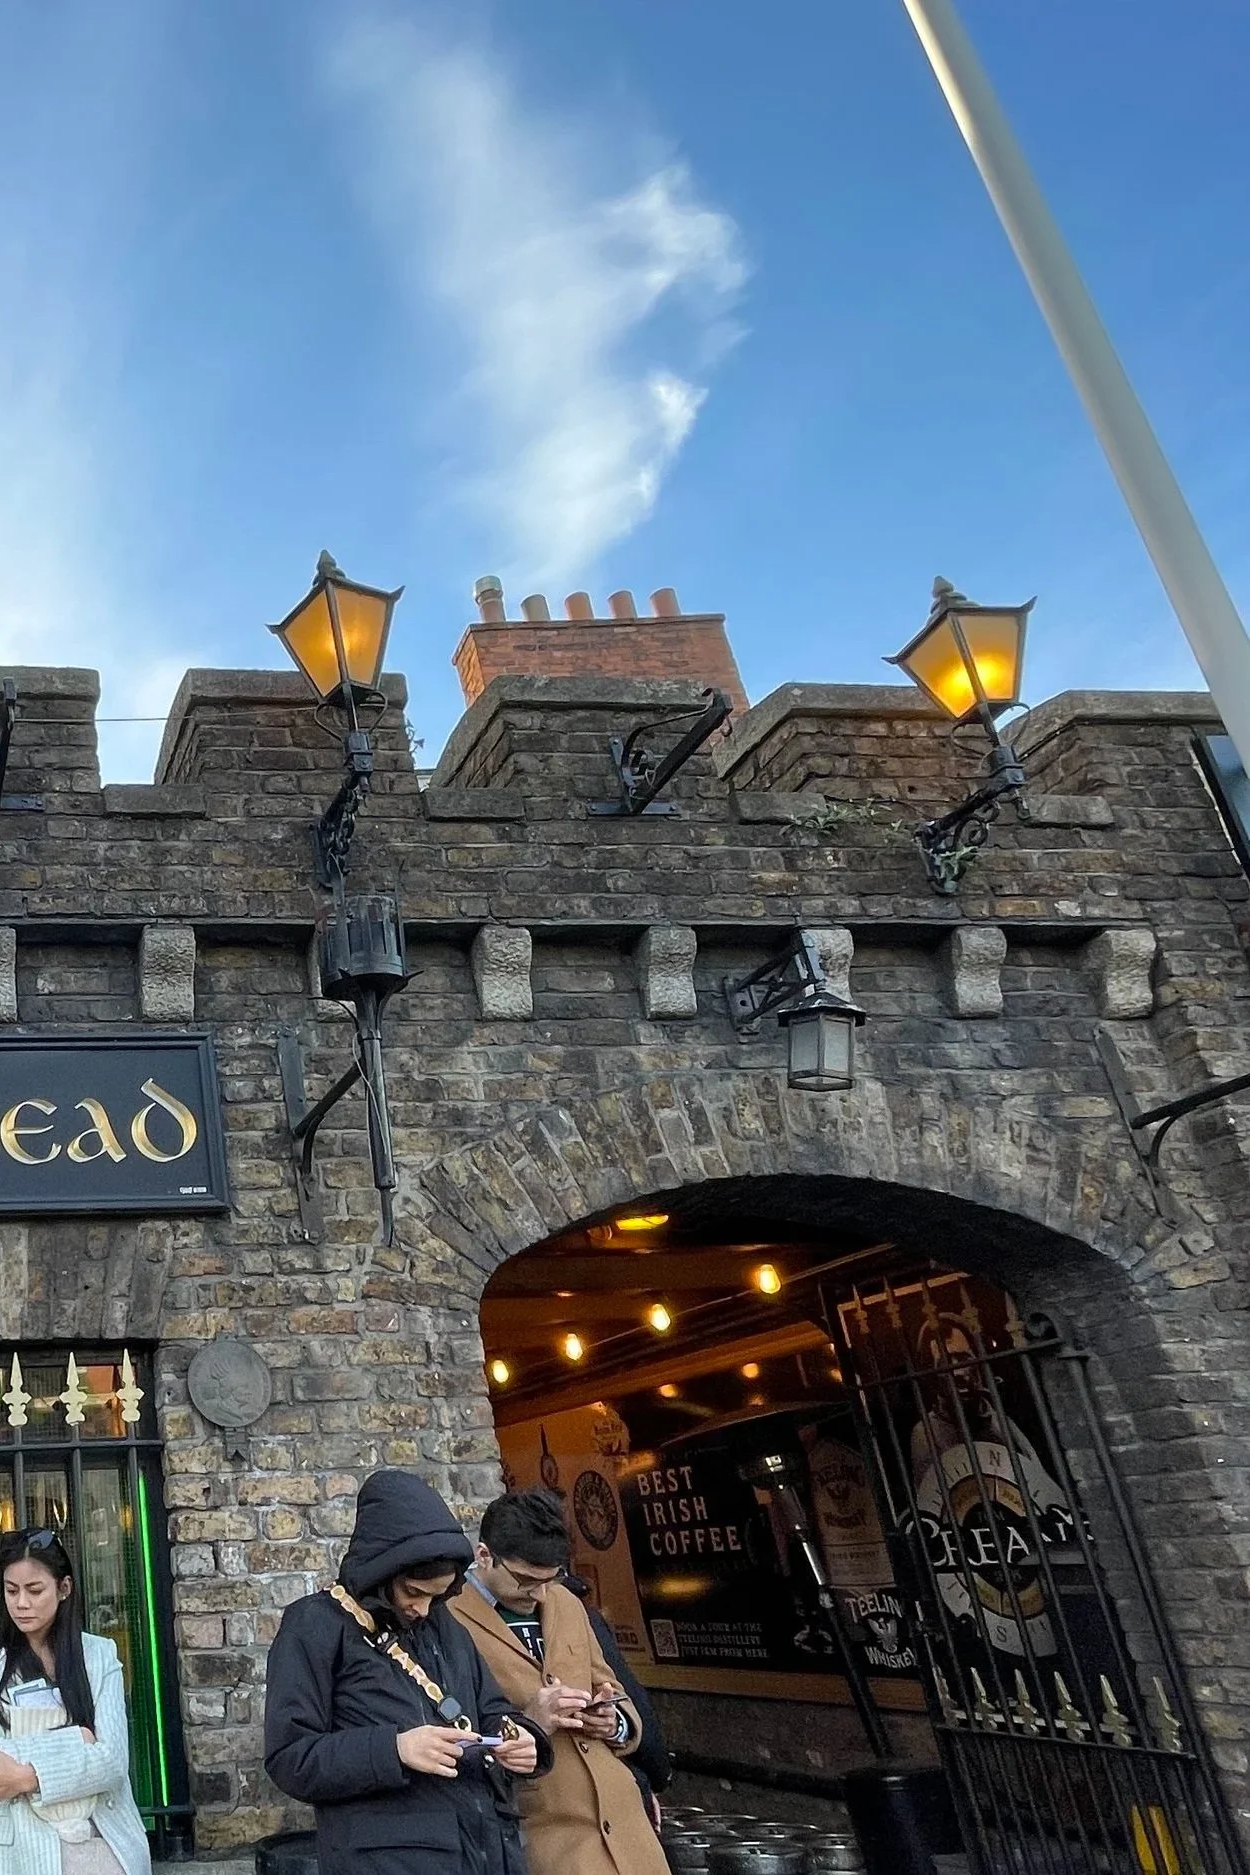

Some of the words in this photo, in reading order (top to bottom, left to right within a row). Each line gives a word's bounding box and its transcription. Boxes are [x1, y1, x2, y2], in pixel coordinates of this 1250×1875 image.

[637, 1466, 693, 1496] BEST
[642, 1496, 708, 1526] IRISH
[650, 1526, 742, 1556] COFFEE
[844, 1592, 904, 1623] TEELIN
